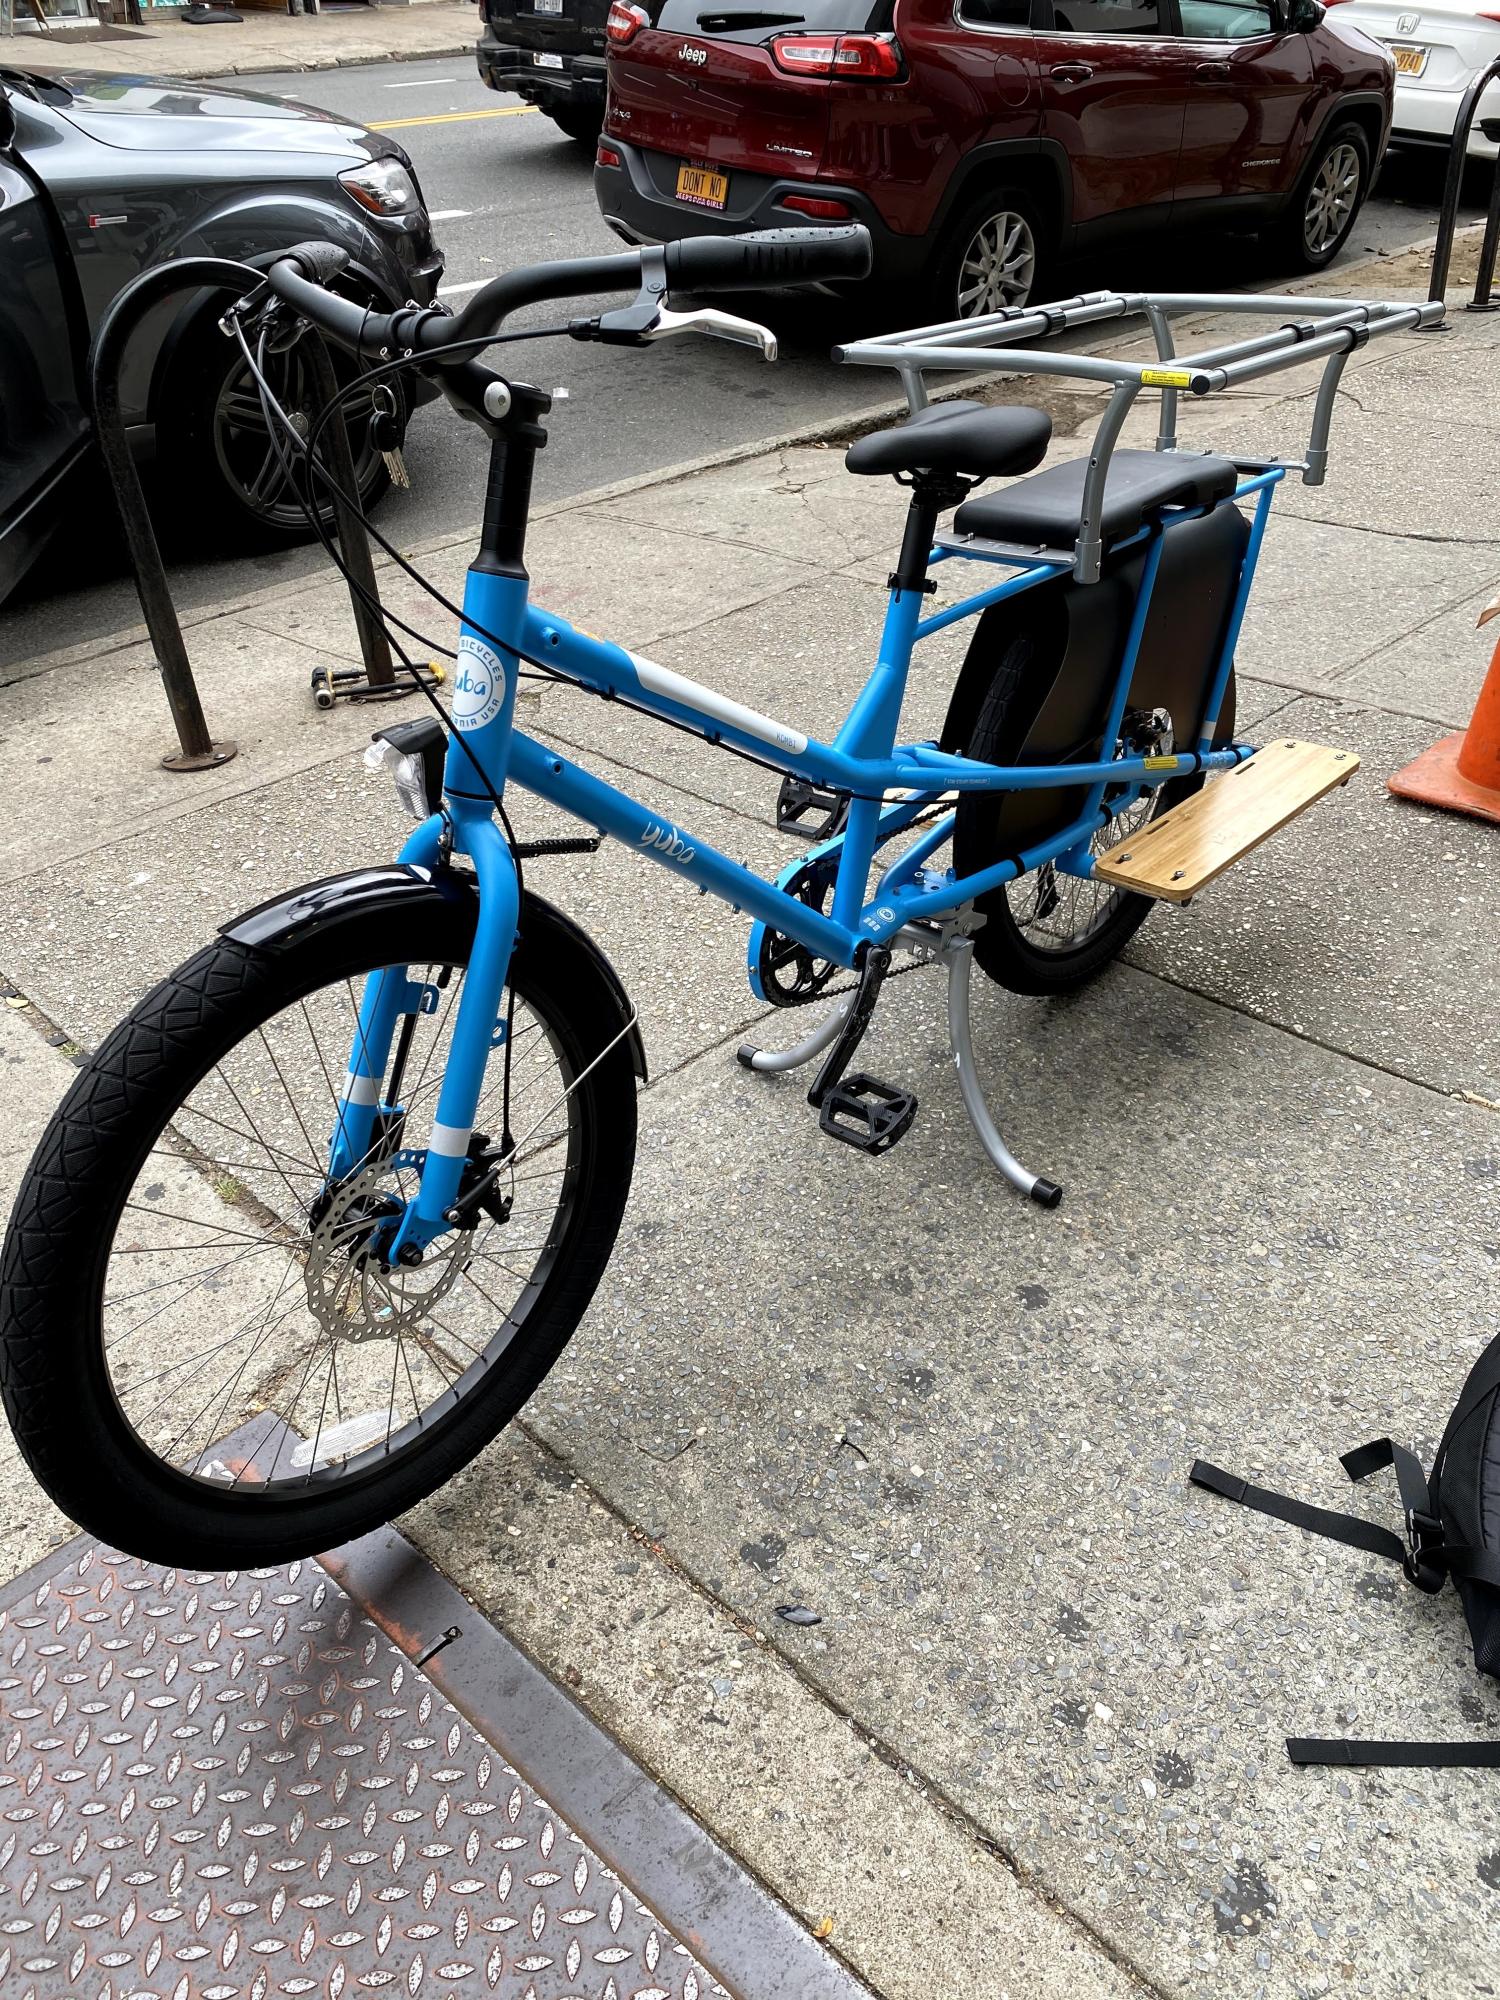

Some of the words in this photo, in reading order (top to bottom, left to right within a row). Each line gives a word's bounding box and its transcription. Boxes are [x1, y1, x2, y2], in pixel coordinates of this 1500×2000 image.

[678, 43, 707, 65] Jeep
[1398, 53, 1420, 69] 9741
[1241, 158, 1281, 168] CHEROKEE
[682, 170, 706, 194] DONT
[708, 176, 722, 198] NO
[460, 639, 503, 682] BICYCLES
[480, 698, 500, 721] USA
[776, 731, 797, 749] KOMBI
[635, 821, 696, 864] yuba
